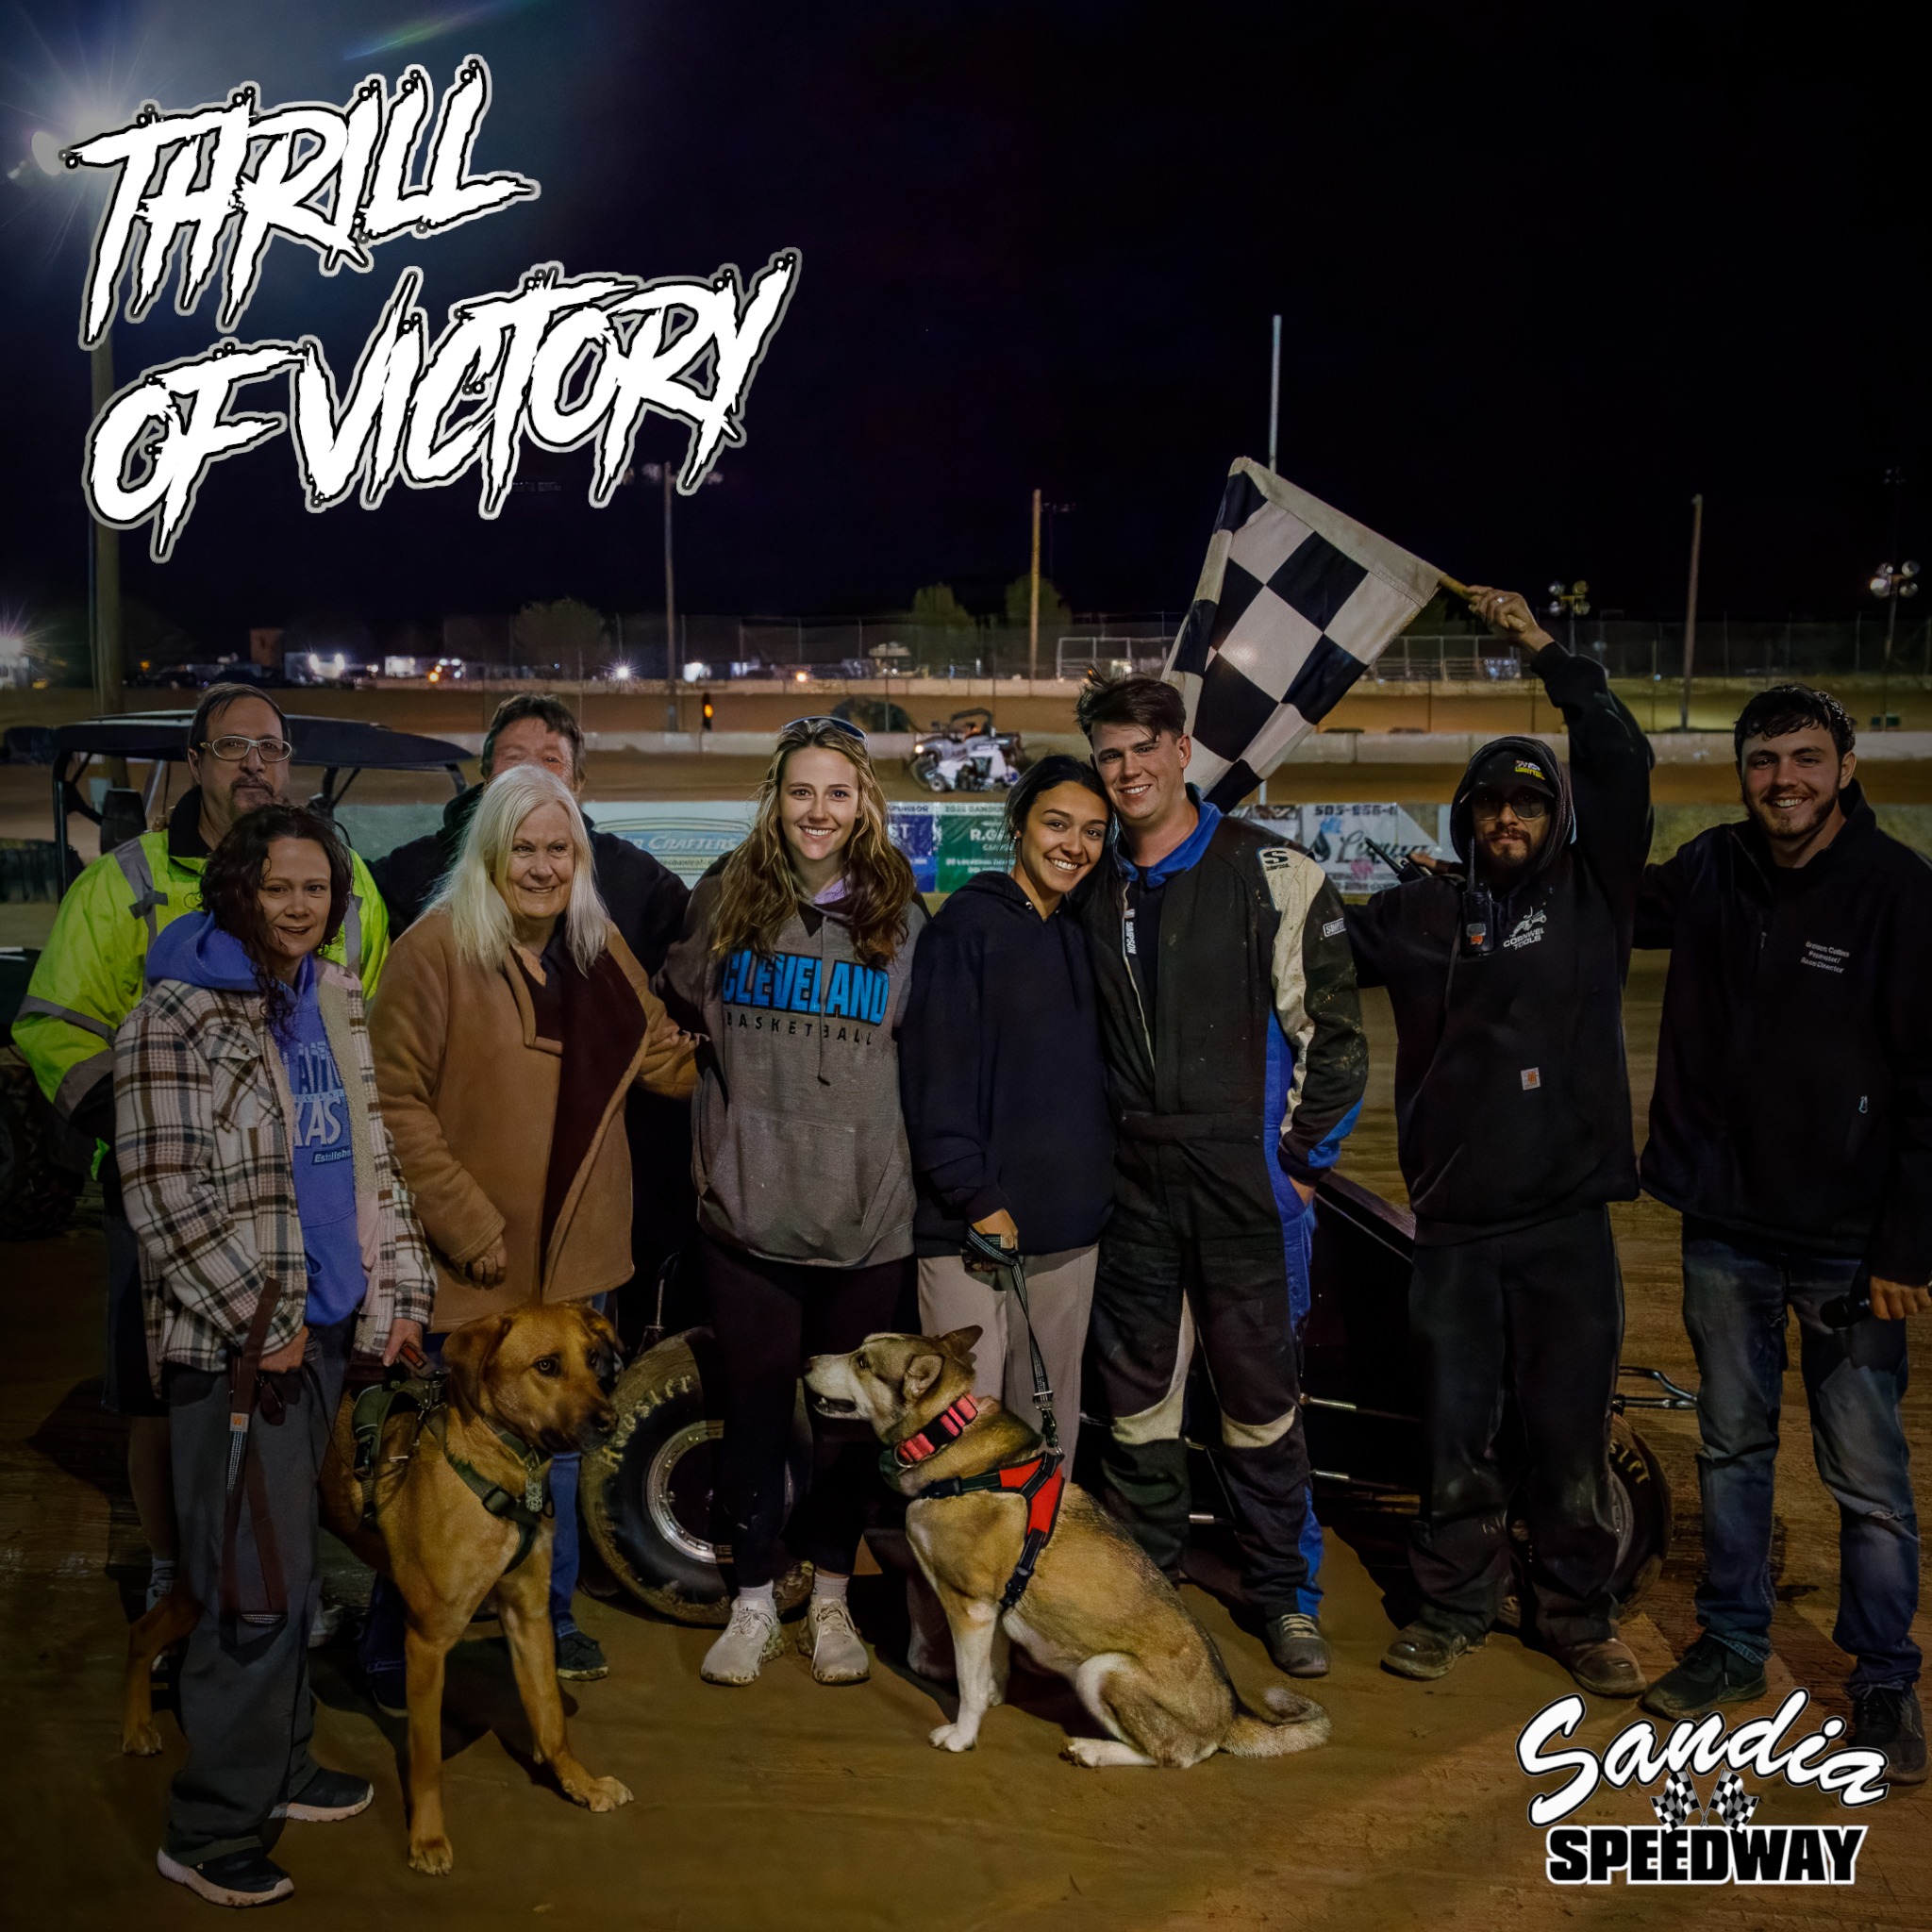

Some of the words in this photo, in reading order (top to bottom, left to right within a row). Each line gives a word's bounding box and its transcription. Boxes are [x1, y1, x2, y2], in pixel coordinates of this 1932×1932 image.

[1513, 934, 1541, 951] TOOLS
[722, 949, 891, 1027] CLEVELAND
[726, 1011, 873, 1046] BASKETBALL
